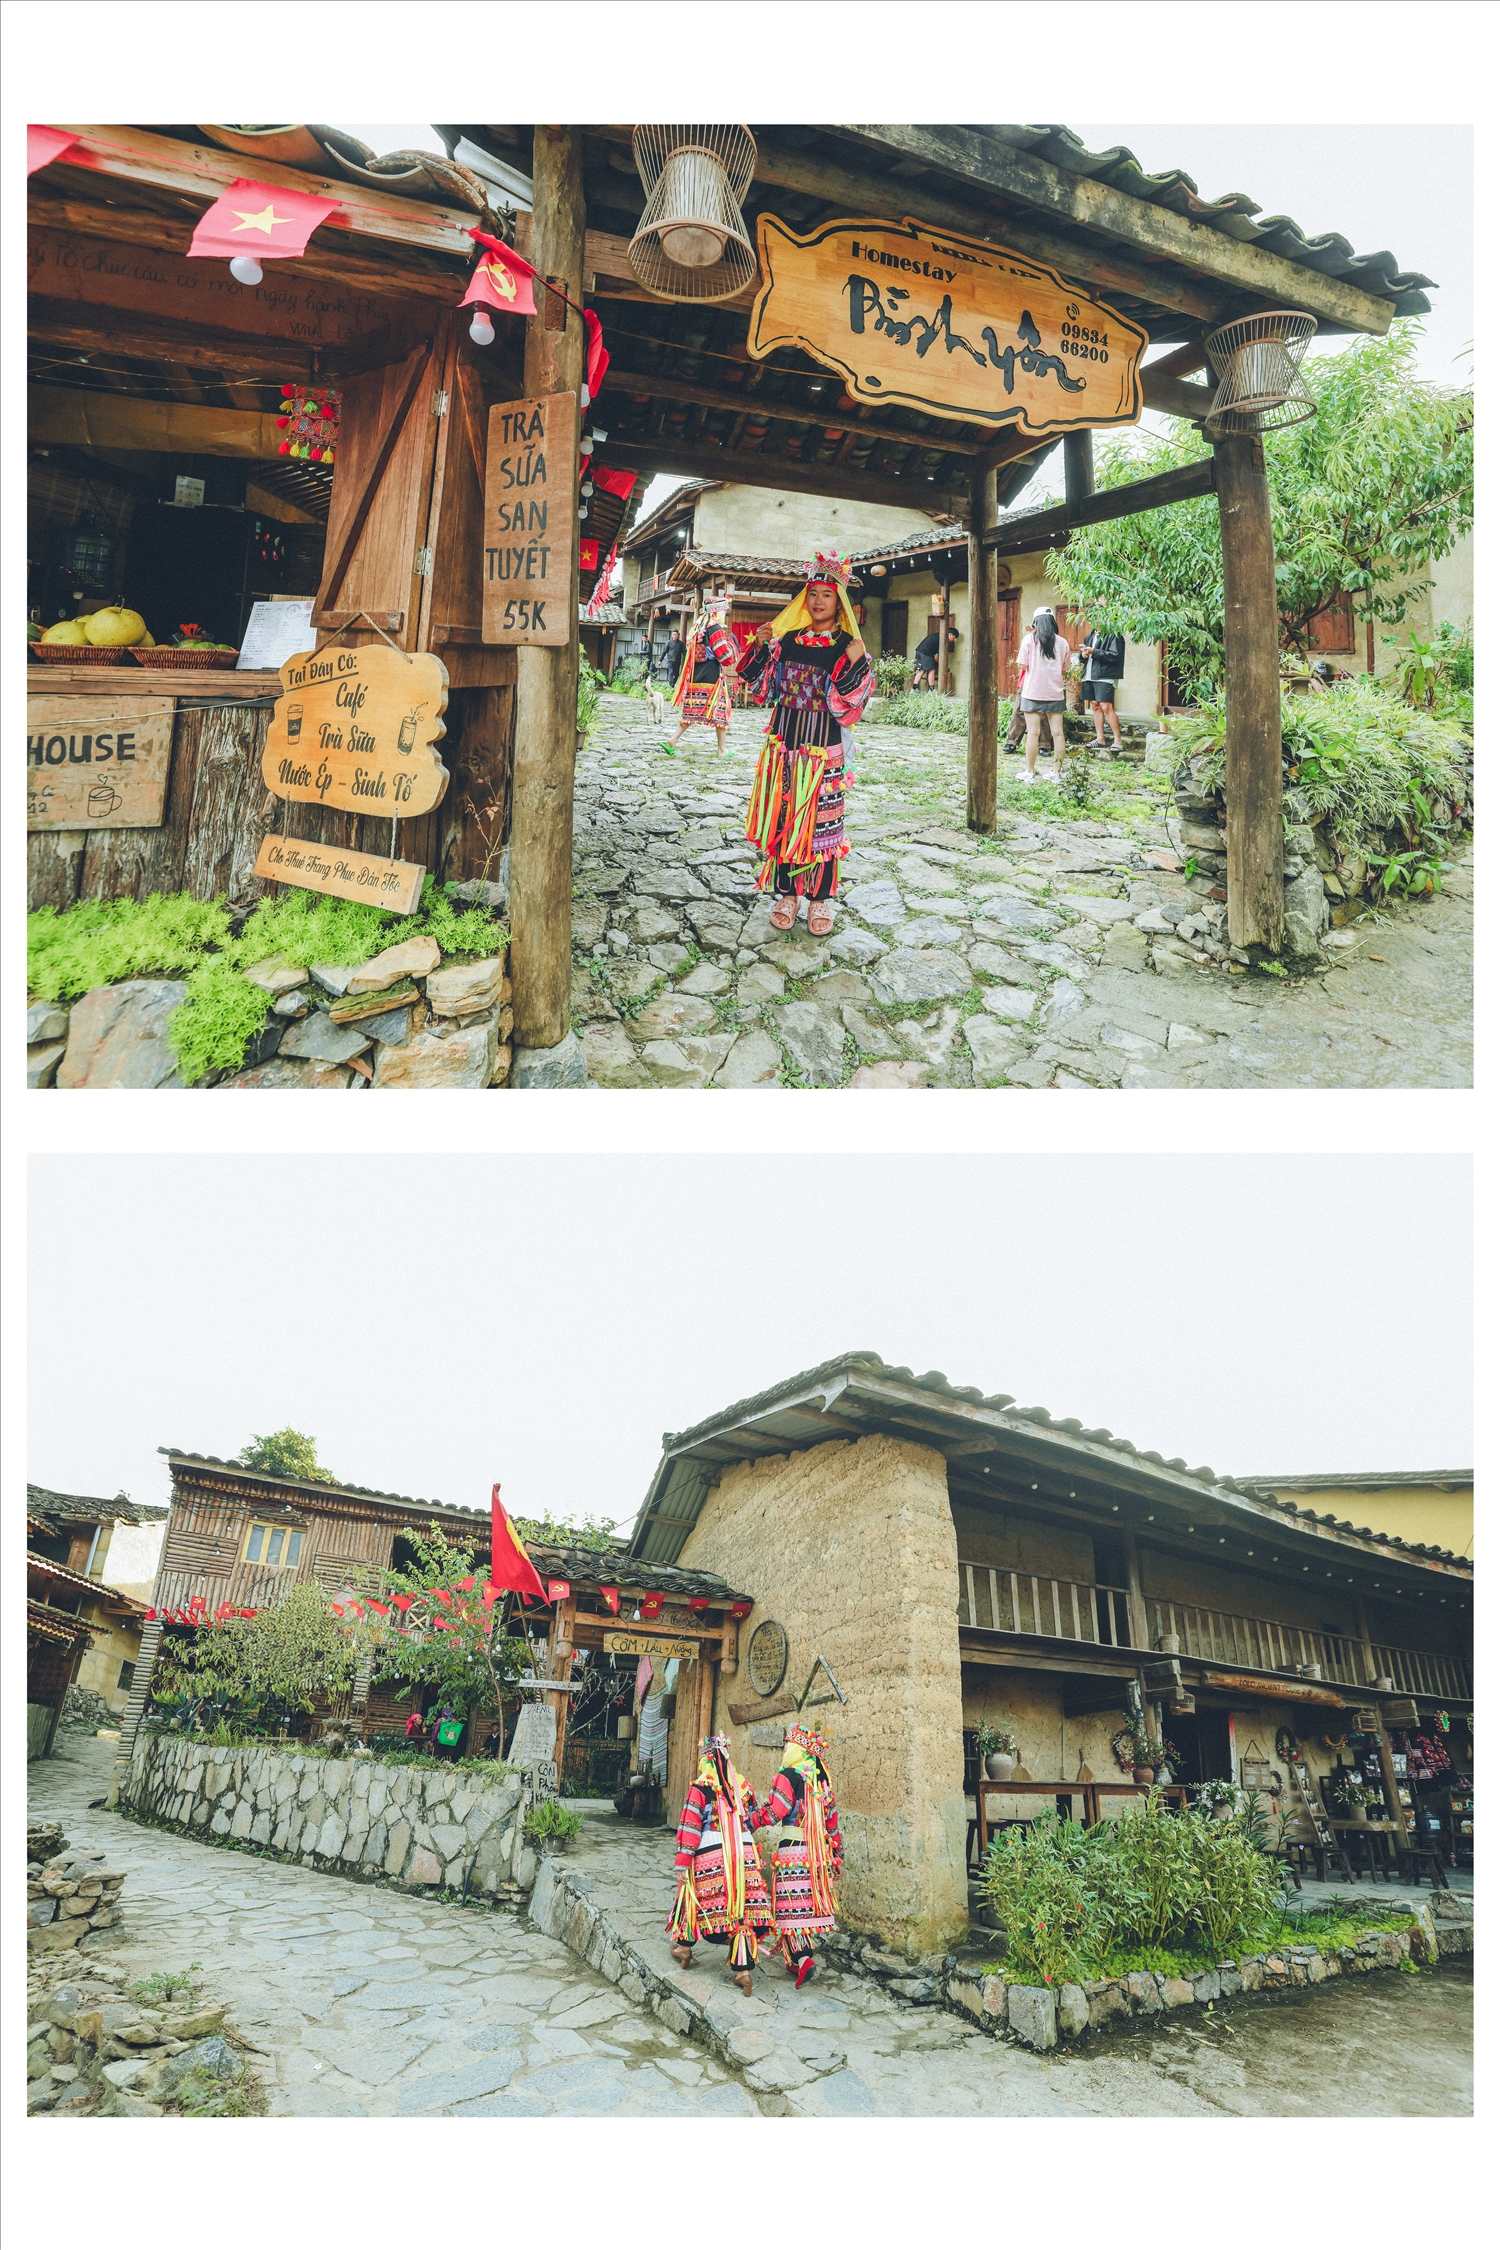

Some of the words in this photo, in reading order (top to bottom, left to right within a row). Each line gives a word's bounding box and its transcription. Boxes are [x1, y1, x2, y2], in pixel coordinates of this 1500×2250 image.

[851, 241, 957, 283] Homestay
[1060, 339, 1109, 364] 66200
[1061, 322, 1109, 347] 09834
[501, 402, 544, 444] TRÀ
[500, 443, 547, 490] SỮA
[498, 500, 547, 532] SAN
[485, 531, 551, 581] TUYẾT
[503, 600, 546, 631] 55K
[288, 665, 306, 686] Tại
[310, 660, 333, 680] Đây
[337, 653, 357, 671] Có:
[336, 681, 369, 718] Café
[318, 722, 344, 750] Trà
[346, 724, 376, 753] Sữa
[278, 758, 312, 787] Nước
[315, 756, 333, 799] Ép
[351, 767, 388, 799] Sinh
[392, 772, 418, 802] Tố
[268, 846, 283, 864] Cho
[284, 850, 306, 869] Thuê
[305, 855, 332, 881] Trang
[332, 860, 356, 884] Phục
